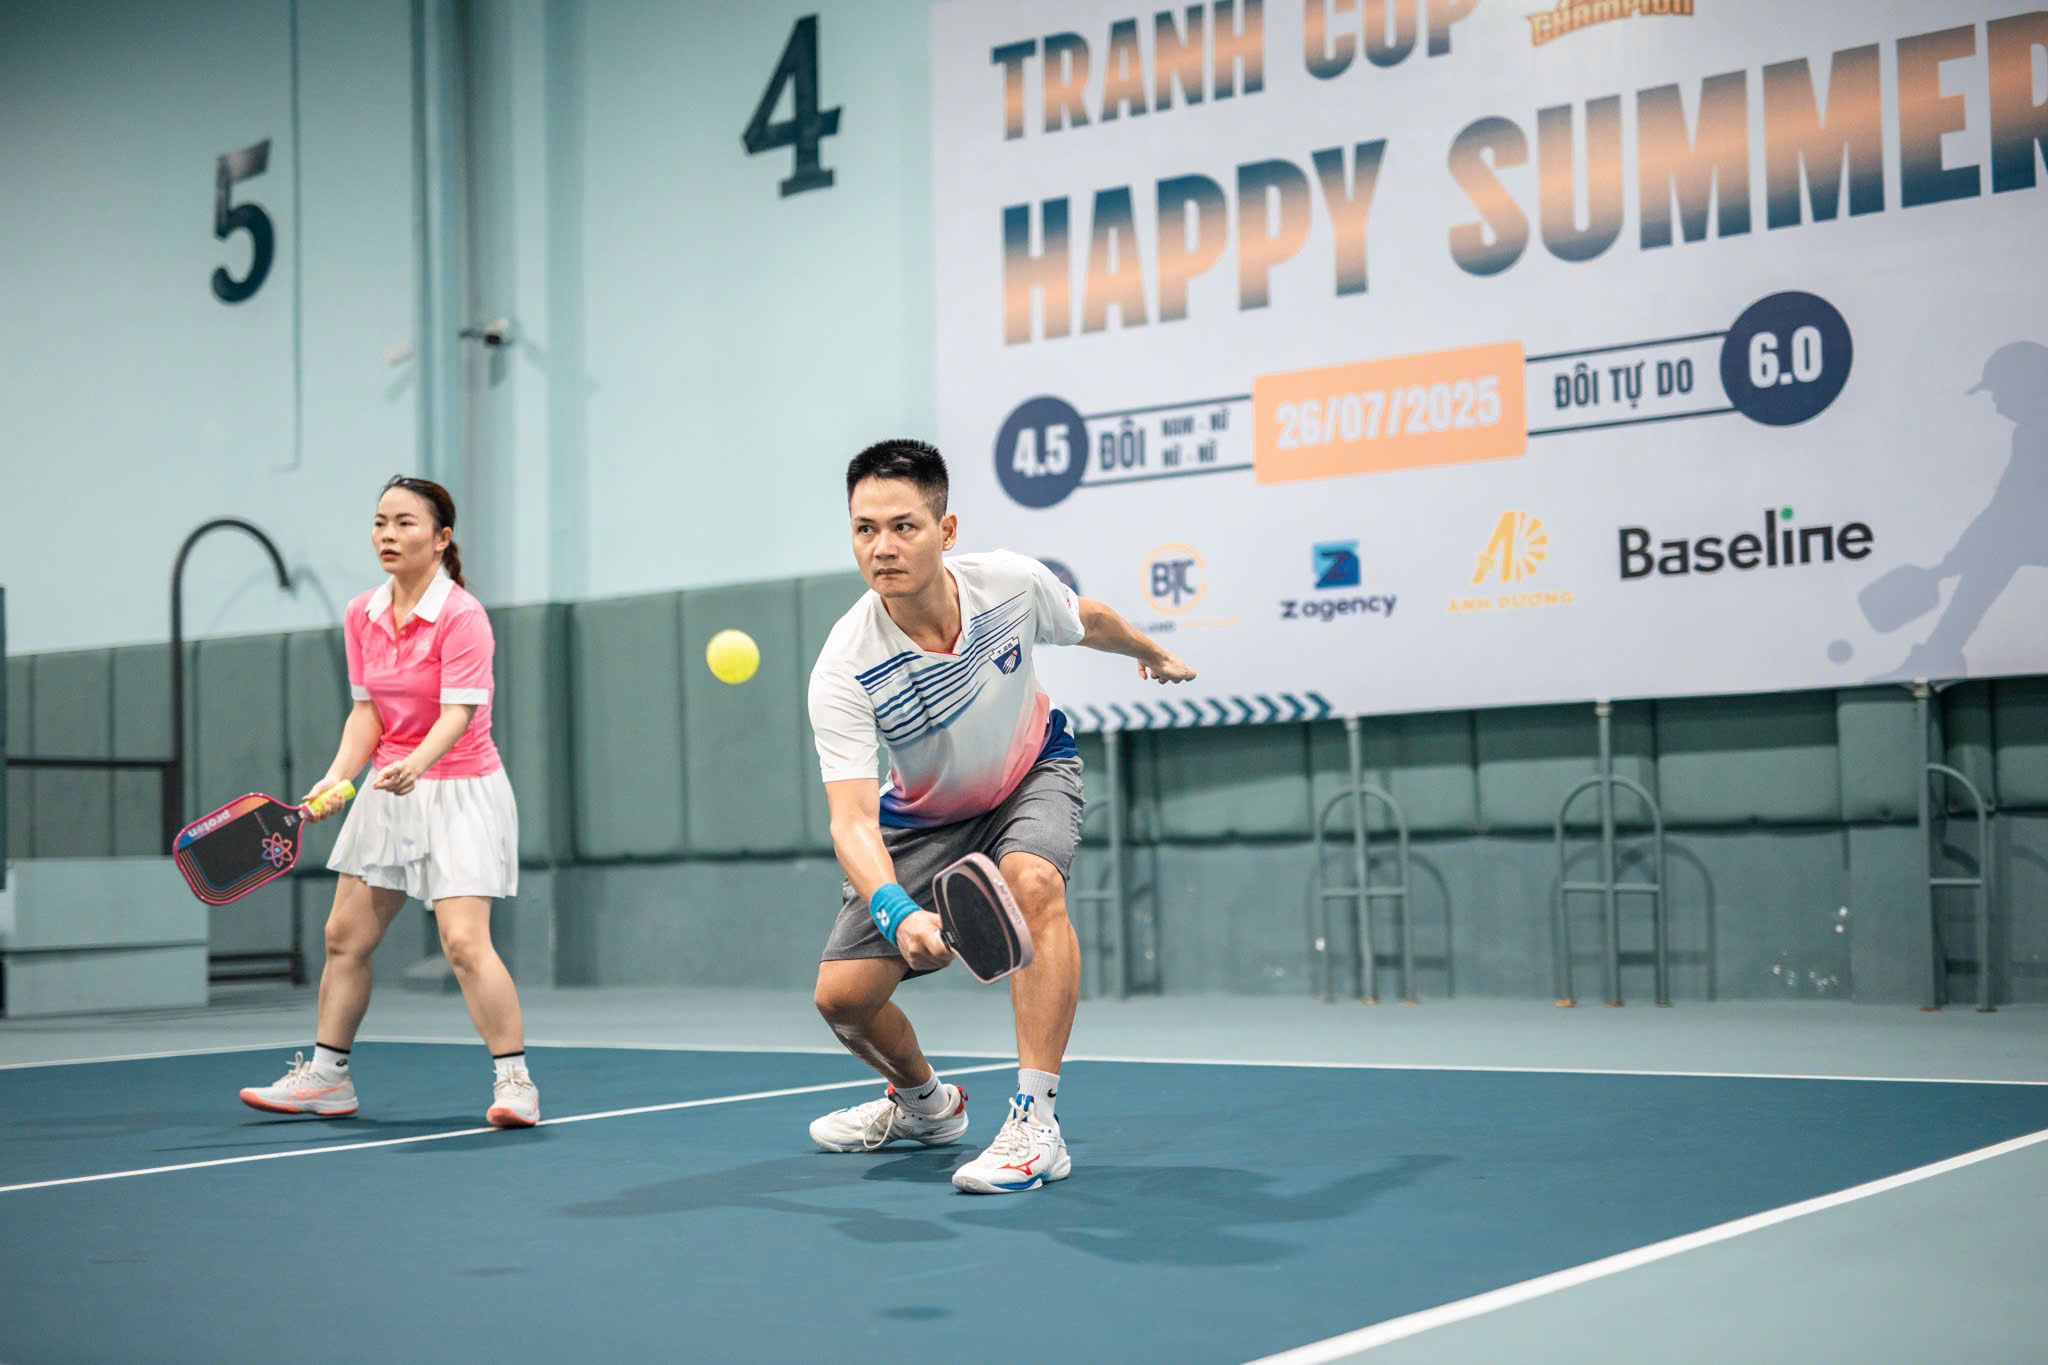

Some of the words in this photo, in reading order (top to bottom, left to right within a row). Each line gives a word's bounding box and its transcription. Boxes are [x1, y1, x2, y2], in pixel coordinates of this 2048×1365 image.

[741, 14, 843, 198] 4
[991, 0, 1265, 141] TRANH
[1002, 138, 1388, 346] HAPPY
[1447, 10, 2048, 278] SUMMER
[211, 139, 276, 304] 5
[1553, 363, 1599, 409] ĐÔI
[1610, 358, 1646, 408] TỰ
[1657, 358, 1694, 398] DO
[1748, 324, 1824, 389] 6.0
[1012, 423, 1072, 478] 4.5
[1274, 376, 1501, 451] 26/07/2025
[1618, 507, 1875, 581] Baseline
